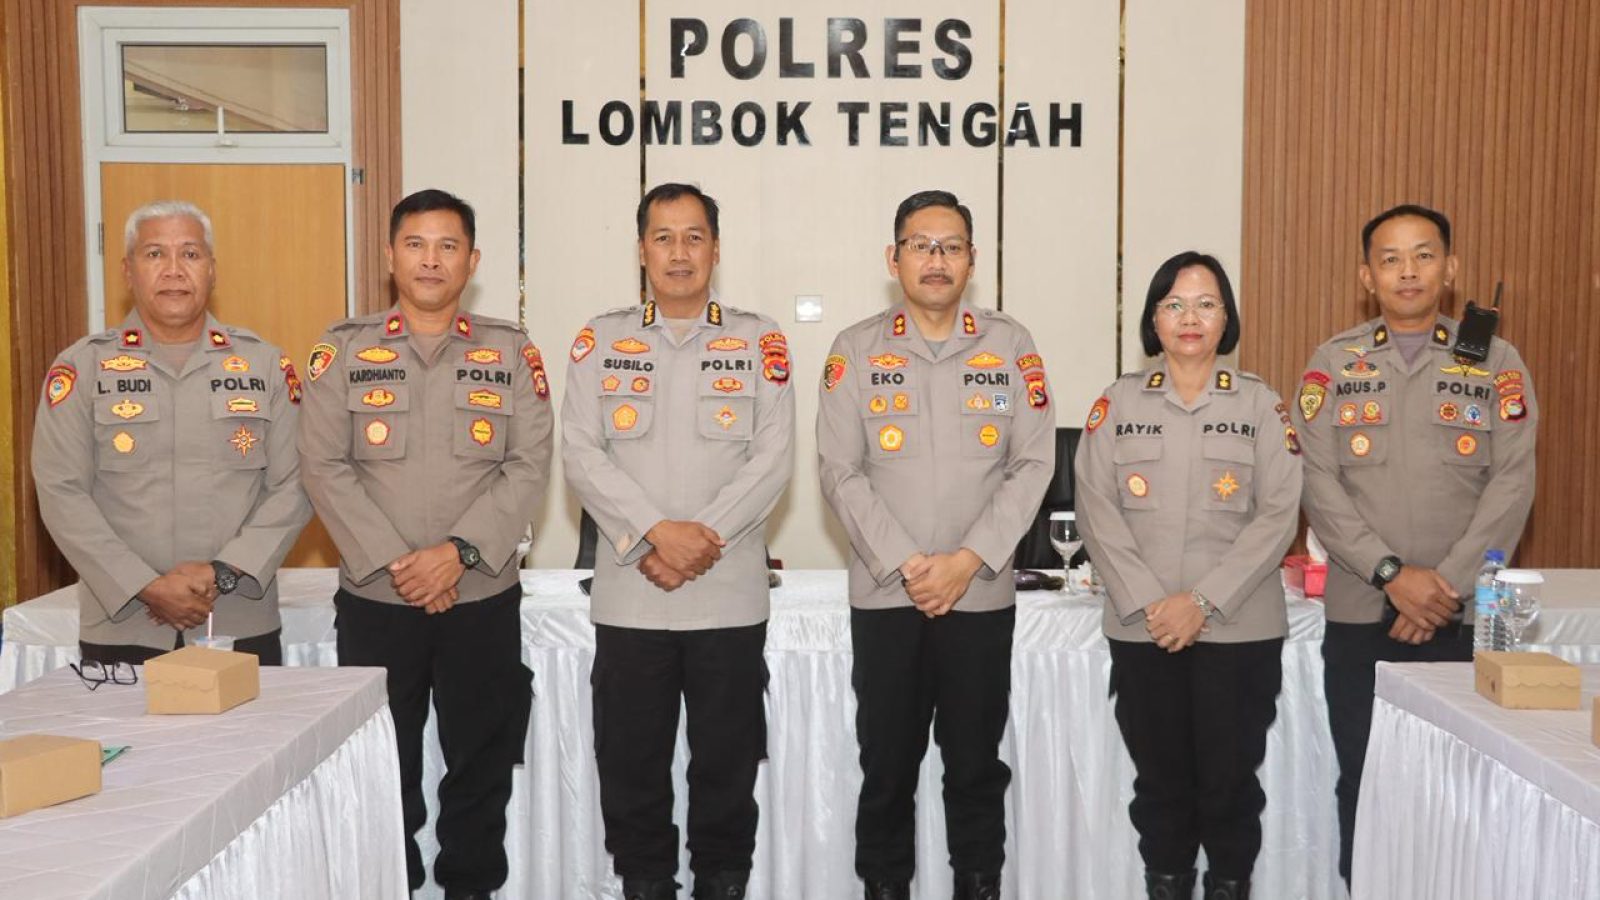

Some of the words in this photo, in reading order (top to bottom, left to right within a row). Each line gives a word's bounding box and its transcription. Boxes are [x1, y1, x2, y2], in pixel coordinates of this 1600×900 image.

[671, 18, 972, 80] POLRES
[562, 100, 812, 146] LOMBOK
[837, 102, 1082, 147] TENGAH
[603, 358, 654, 372] SUSILO
[701, 360, 752, 371] POLRI
[350, 369, 406, 384] KARDHIANTO
[457, 369, 512, 386] POLRI
[871, 373, 904, 385] EKO
[964, 373, 1009, 386] POLRI
[97, 381, 111, 395] L.
[117, 378, 151, 393] BUDI
[211, 378, 266, 392] POLRI
[1336, 381, 1386, 397] AGUS.P
[1437, 381, 1490, 399] POLRI
[1116, 423, 1163, 436] RAYIK
[1204, 423, 1255, 438] POLRI
